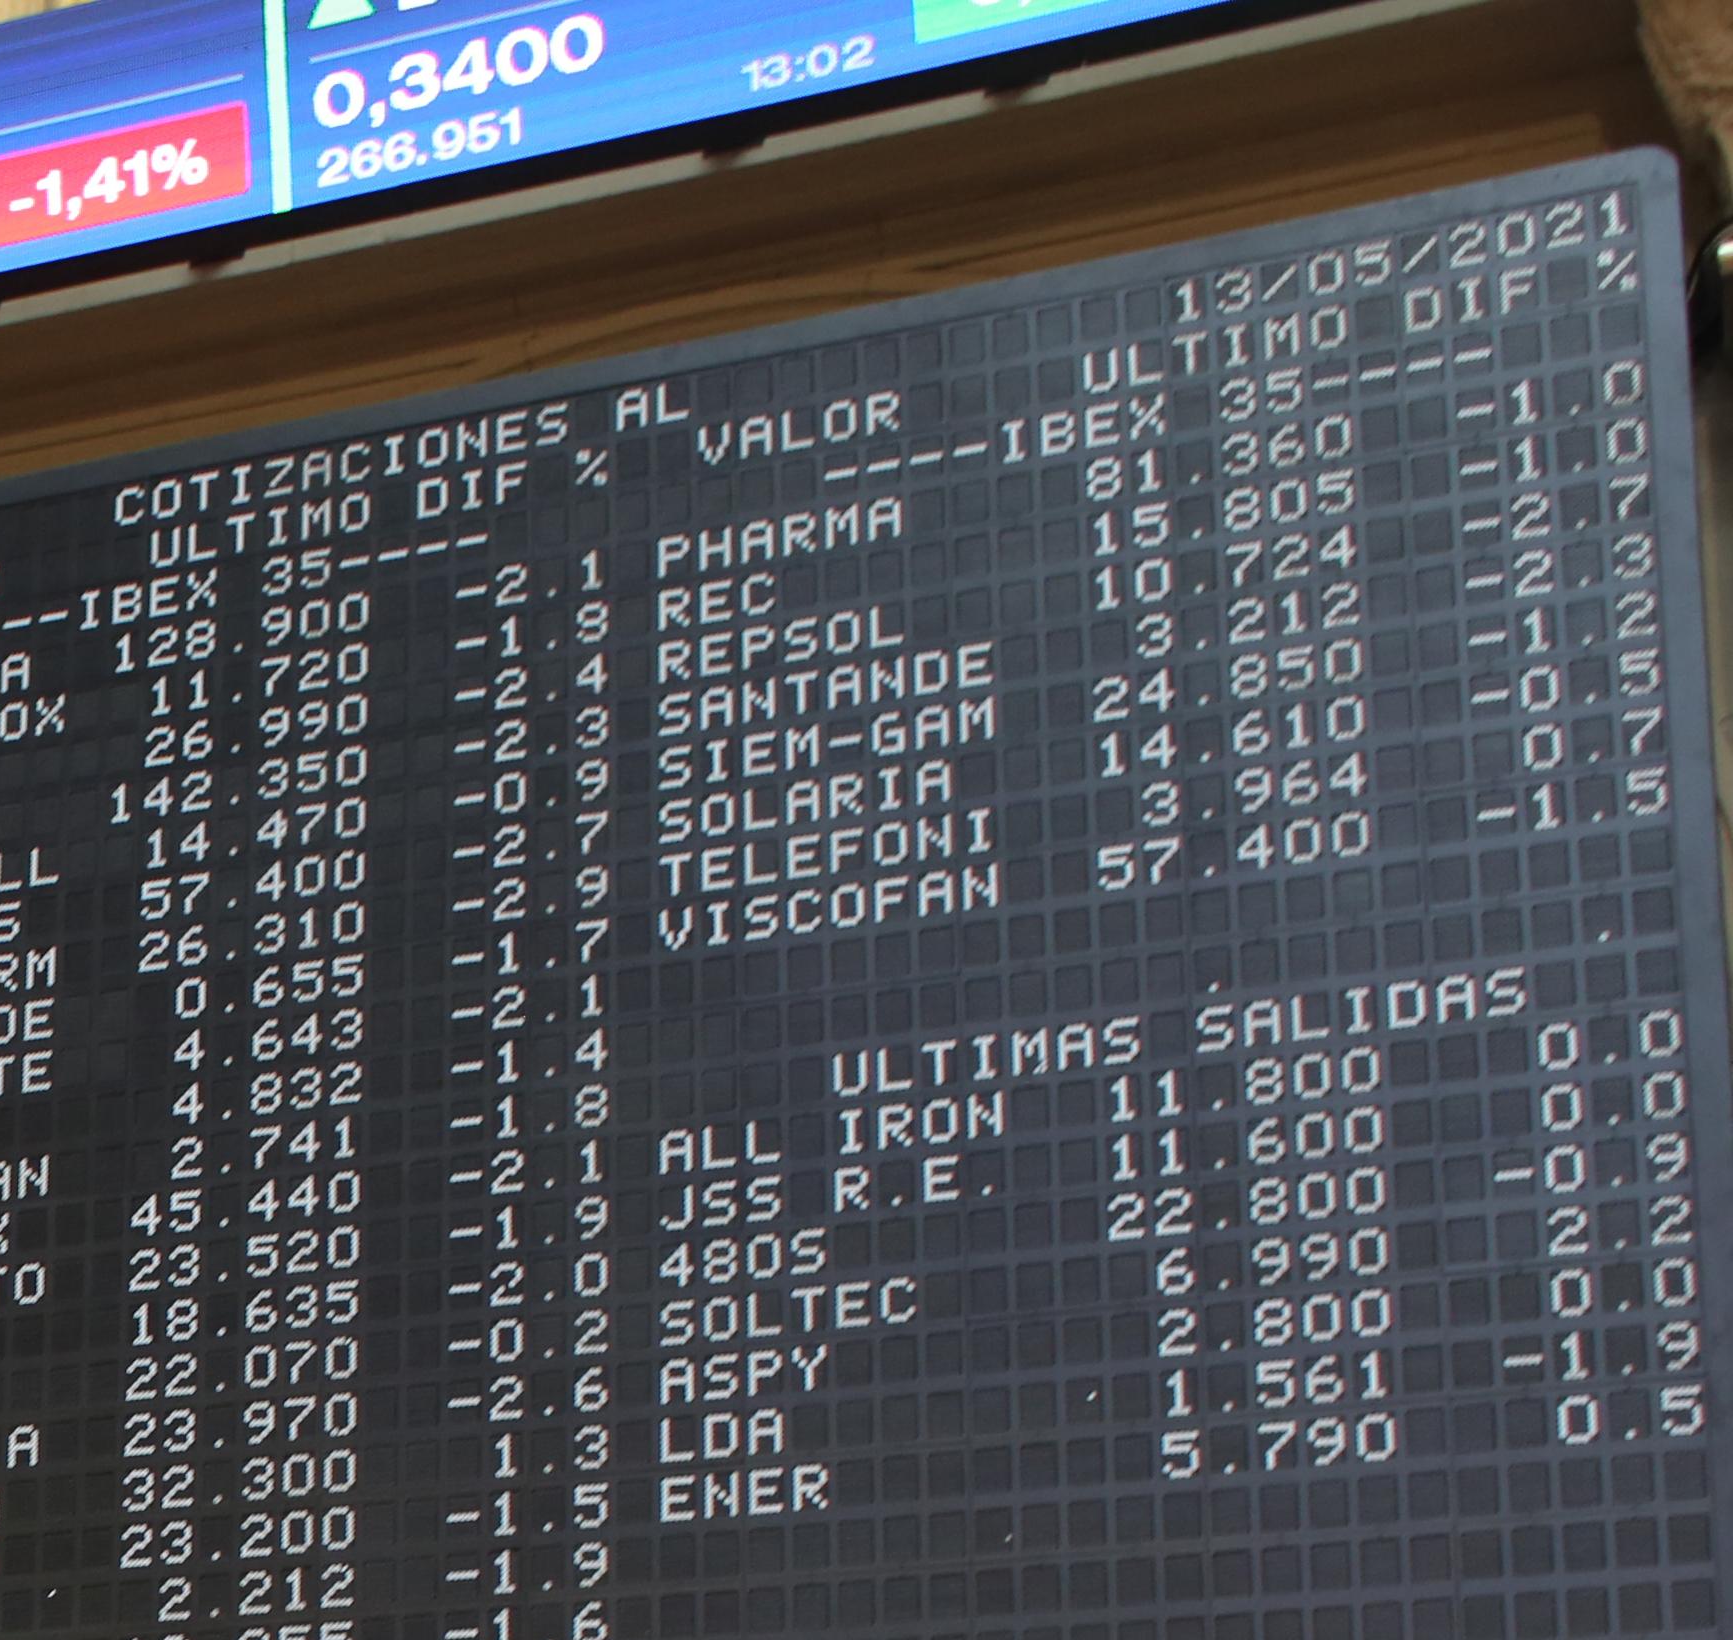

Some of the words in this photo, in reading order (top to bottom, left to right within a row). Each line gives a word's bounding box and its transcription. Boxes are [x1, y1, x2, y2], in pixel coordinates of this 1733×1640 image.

[312, 13, 606, 129] 0,3400
[739, 35, 877, 92] 13:02
[9, 140, 209, 222] -1,41%
[316, 107, 525, 188] 266.951
[1176, 191, 1627, 324] 13/05/2021
[697, 390, 900, 466] VALOR
[1082, 305, 1347, 394] ULTIMO
[1404, 265, 1537, 334] DIF
[1596, 248, 1637, 292] %
[114, 401, 569, 527] COTIZACIONES
[615, 383, 689, 433] AL
[150, 491, 371, 569] ULTIMO
[416, 460, 528, 520] DIF
[575, 448, 608, 487] %
[657, 605, 905, 684] REPSOL
[1095, 525, 1357, 611] 10.724
[1461, 472, 1649, 542] -2.7
[110, 744, 368, 825] 142.350
[453, 704, 609, 763] -2.3
[659, 807, 992, 897] TELEFONI
[1141, 751, 1367, 827] 3.964
[1522, 705, 1662, 772] 0.7
[139, 848, 366, 921] 57.400
[452, 809, 609, 869] -2.7
[659, 863, 999, 952] VISCOFAN
[1097, 811, 1370, 892] 57.400
[1476, 766, 1668, 832] -1.5
[171, 1060, 363, 1125] 4.832
[450, 1027, 609, 1084] -1.4
[832, 1015, 1140, 1097] ULTIMAS
[1195, 966, 1527, 1054] SALIDAS
[130, 1169, 361, 1237] 45.440
[449, 1139, 603, 1196] -2.1
[659, 1276, 917, 1347] SOLTEC
[1156, 1226, 1388, 1297] 6.990
[1546, 1194, 1693, 1258] 2.2
[122, 1391, 358, 1458] 23.970
[447, 1366, 608, 1422] -2.6
[124, 1335, 359, 1402] 22.070
[448, 1308, 609, 1363] -0.2
[659, 1463, 829, 1524] ENER
[1161, 1412, 1396, 1480] 5.790
[1556, 1384, 1704, 1446] 0.5
